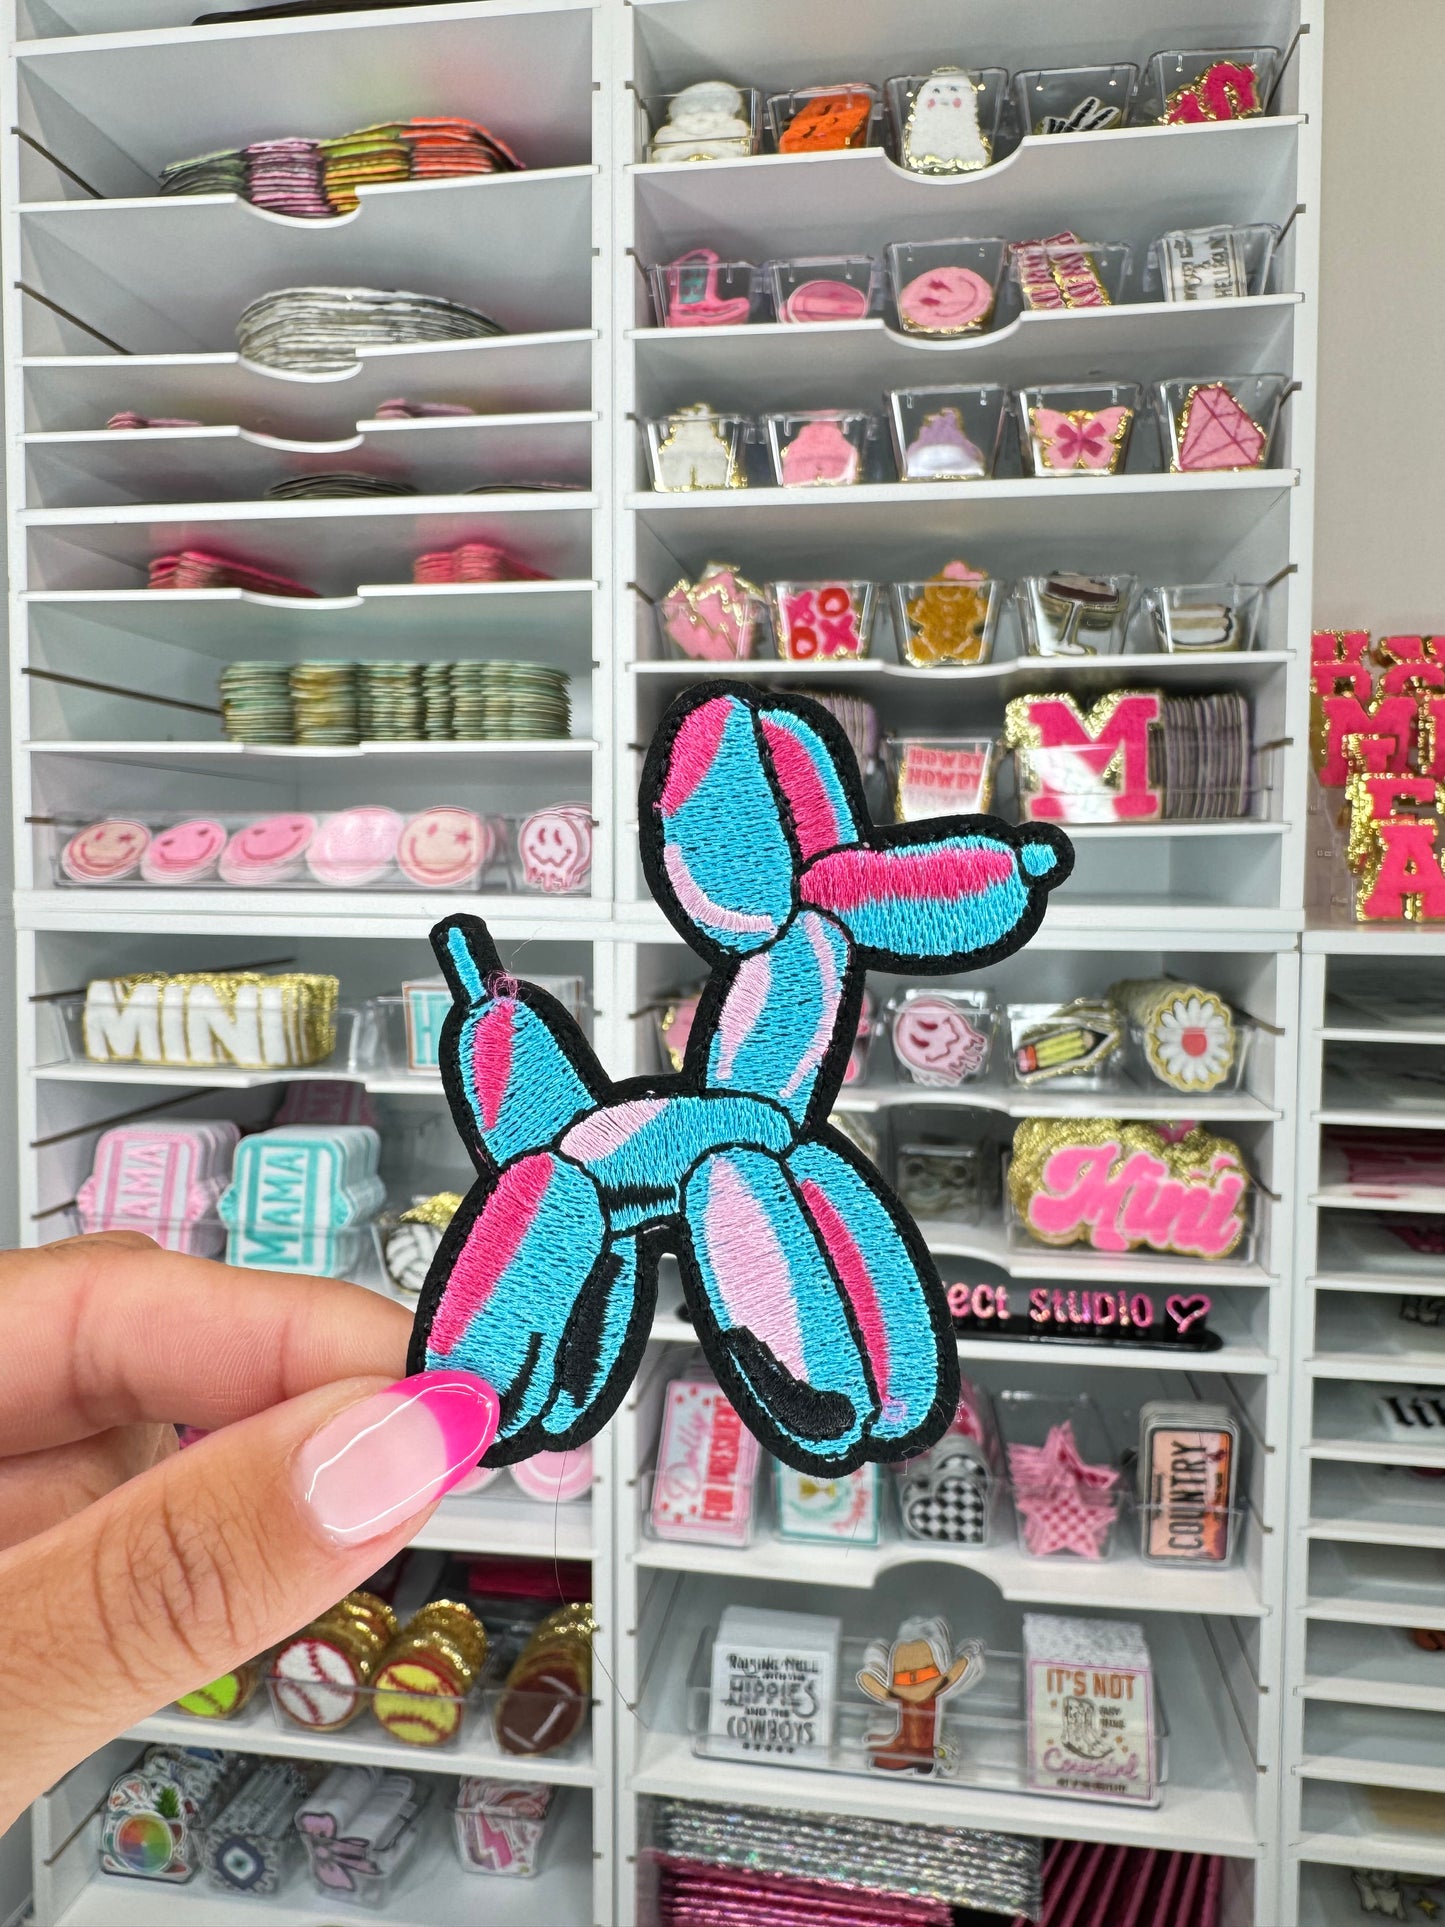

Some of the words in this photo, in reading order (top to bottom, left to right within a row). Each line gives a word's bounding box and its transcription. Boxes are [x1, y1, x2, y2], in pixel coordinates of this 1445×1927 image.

[1030, 699, 1161, 820] M
[86, 979, 291, 1066] MINI
[243, 1149, 306, 1266] MAMA
[1030, 1141, 1244, 1254] Mini
[944, 1281, 1011, 1320] ect
[1167, 1440, 1207, 1550] COUNTRY
[722, 1679, 819, 1718] HIPPIES
[1046, 1668, 1087, 1697] IT'S
[1093, 1672, 1136, 1700] NOT
[726, 1715, 817, 1744] COWBOYS
